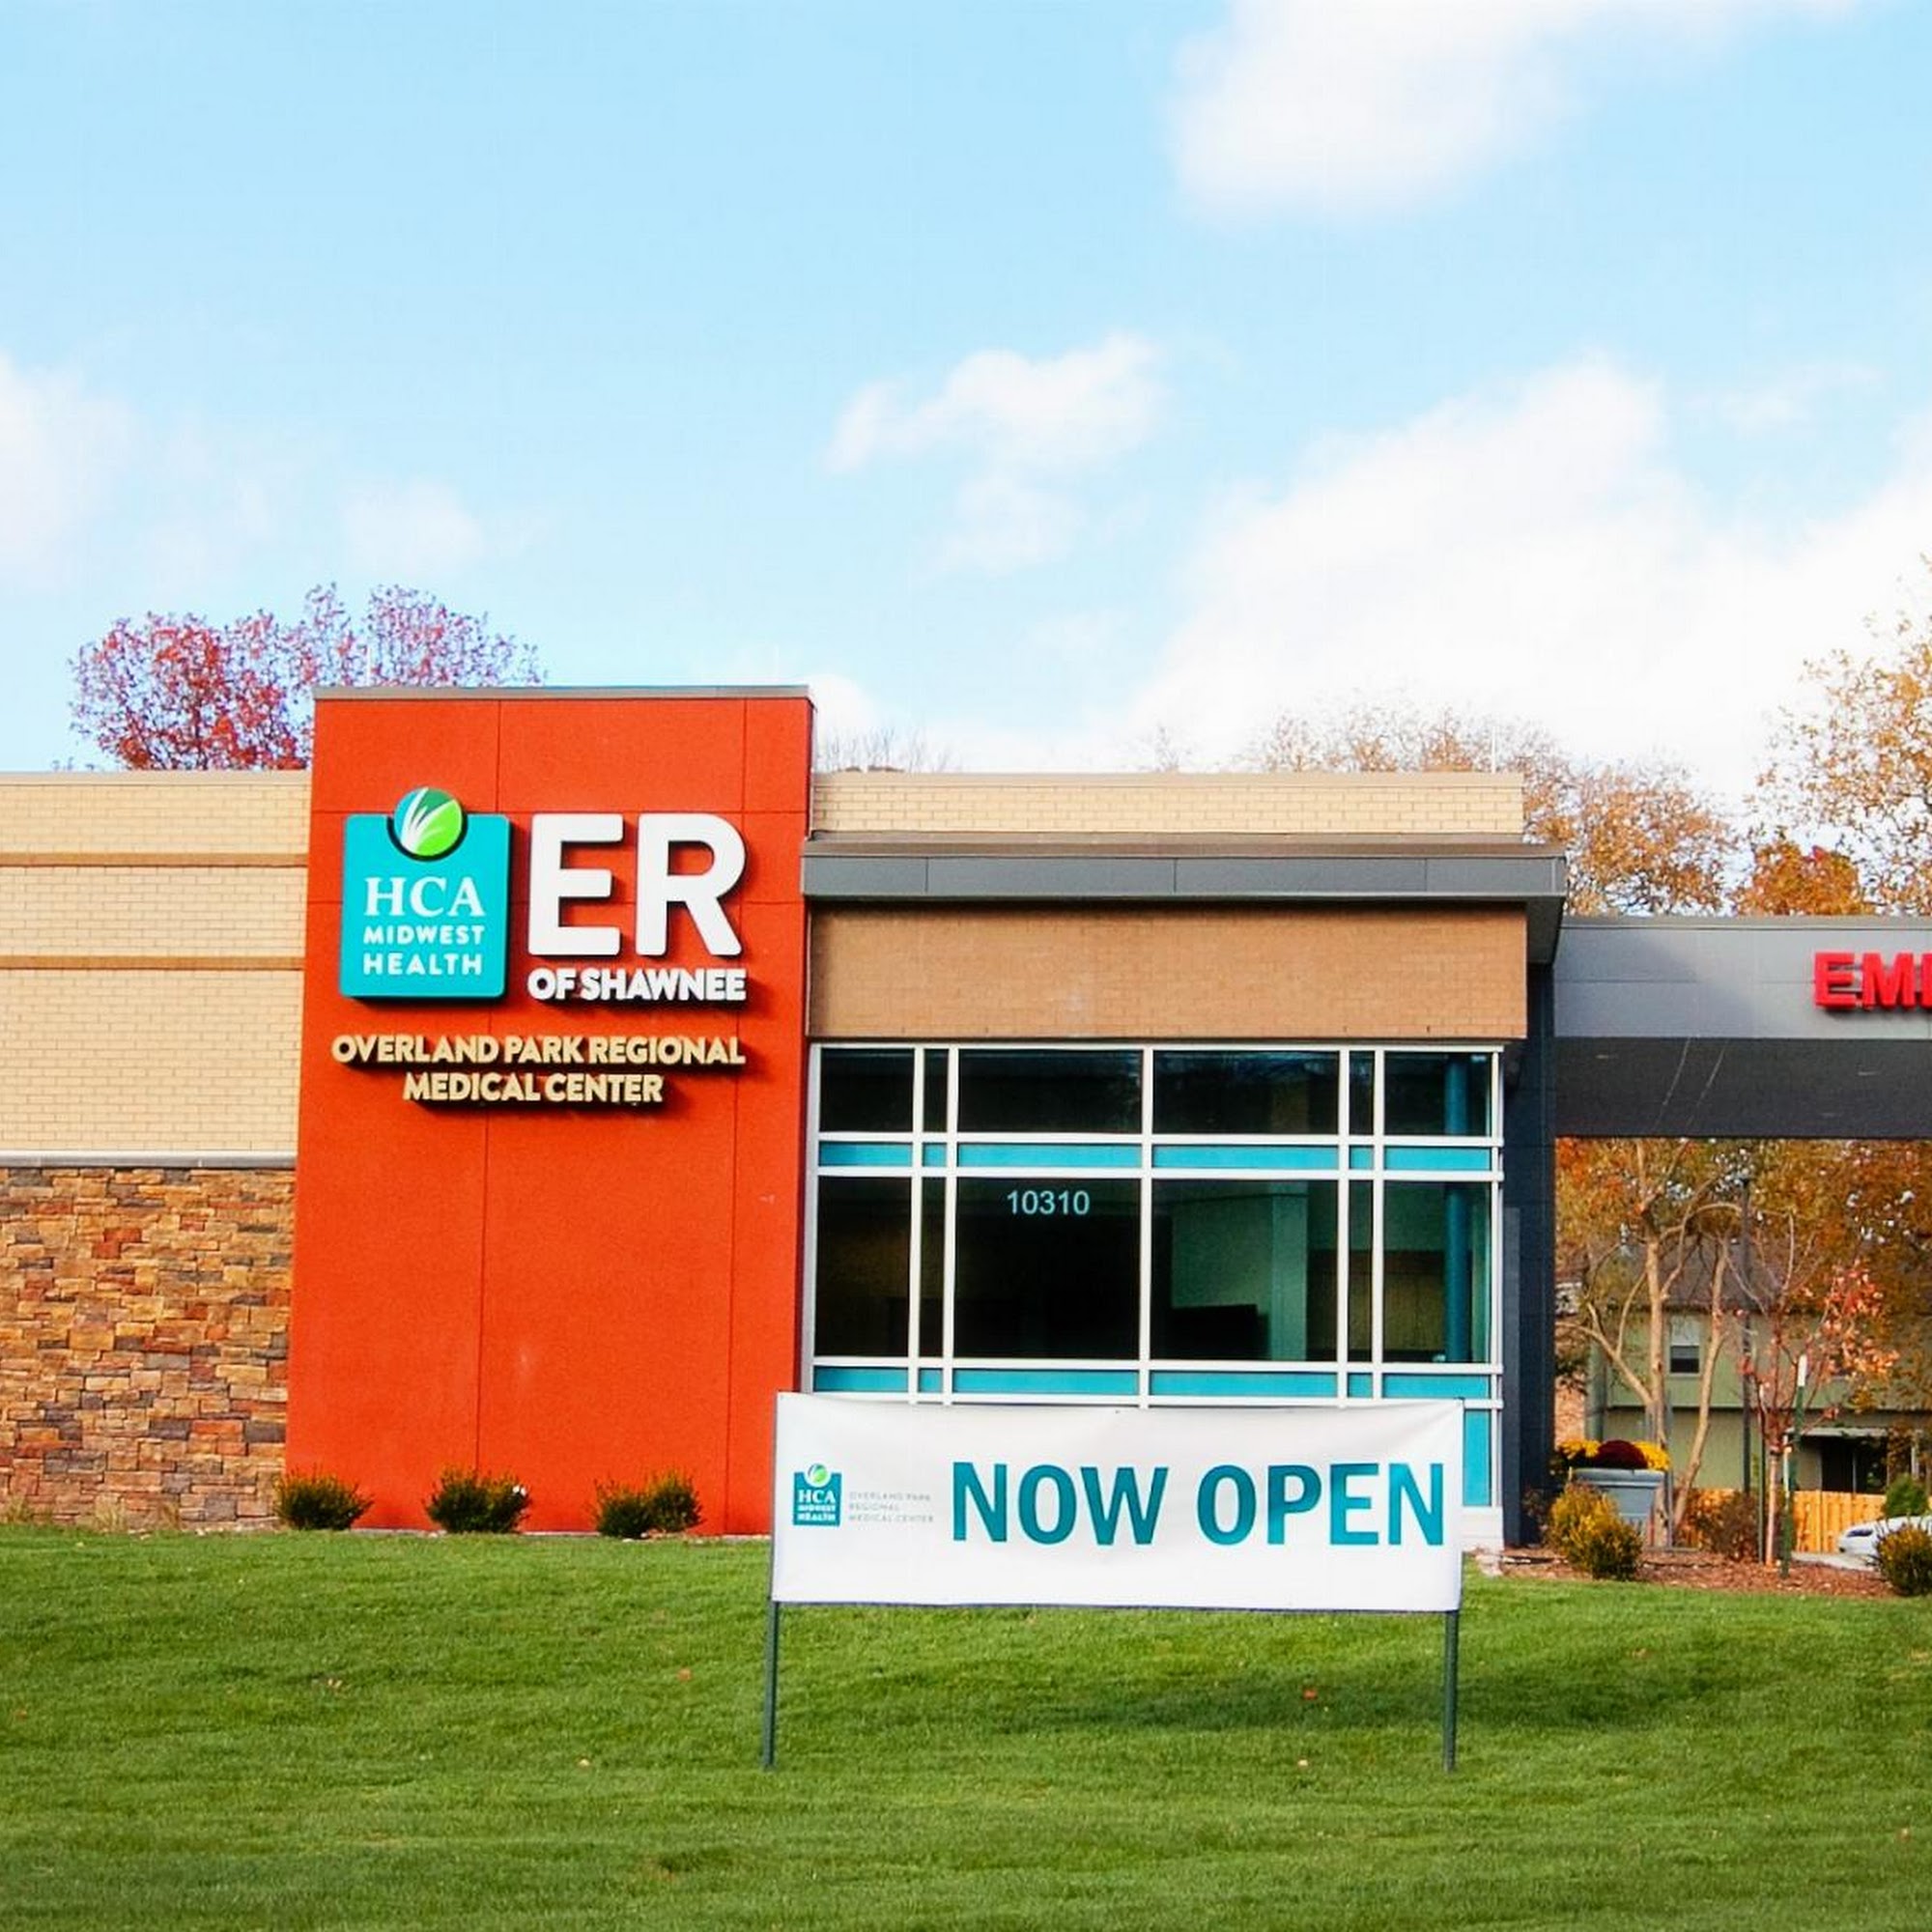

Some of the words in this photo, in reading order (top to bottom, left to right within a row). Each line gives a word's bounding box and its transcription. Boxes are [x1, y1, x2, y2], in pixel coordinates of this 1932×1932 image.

[363, 876, 486, 918] HCA
[527, 812, 746, 956] ER
[363, 924, 485, 945] MIDWEST
[363, 952, 482, 976] HEALTH
[527, 967, 577, 1002] OF
[580, 967, 747, 1002] SHAWNEE
[1814, 952, 1932, 1009] EM
[330, 1034, 499, 1065] OVERLAND
[503, 1035, 584, 1065] PARK
[587, 1035, 747, 1065] REGIONAL
[402, 1071, 541, 1102] MEDICAL
[544, 1072, 664, 1103] CENTER
[1007, 1189, 1091, 1216] 10310
[797, 1489, 837, 1504] HCA
[952, 1461, 1170, 1547] NOW
[1197, 1462, 1445, 1547] OPEN
